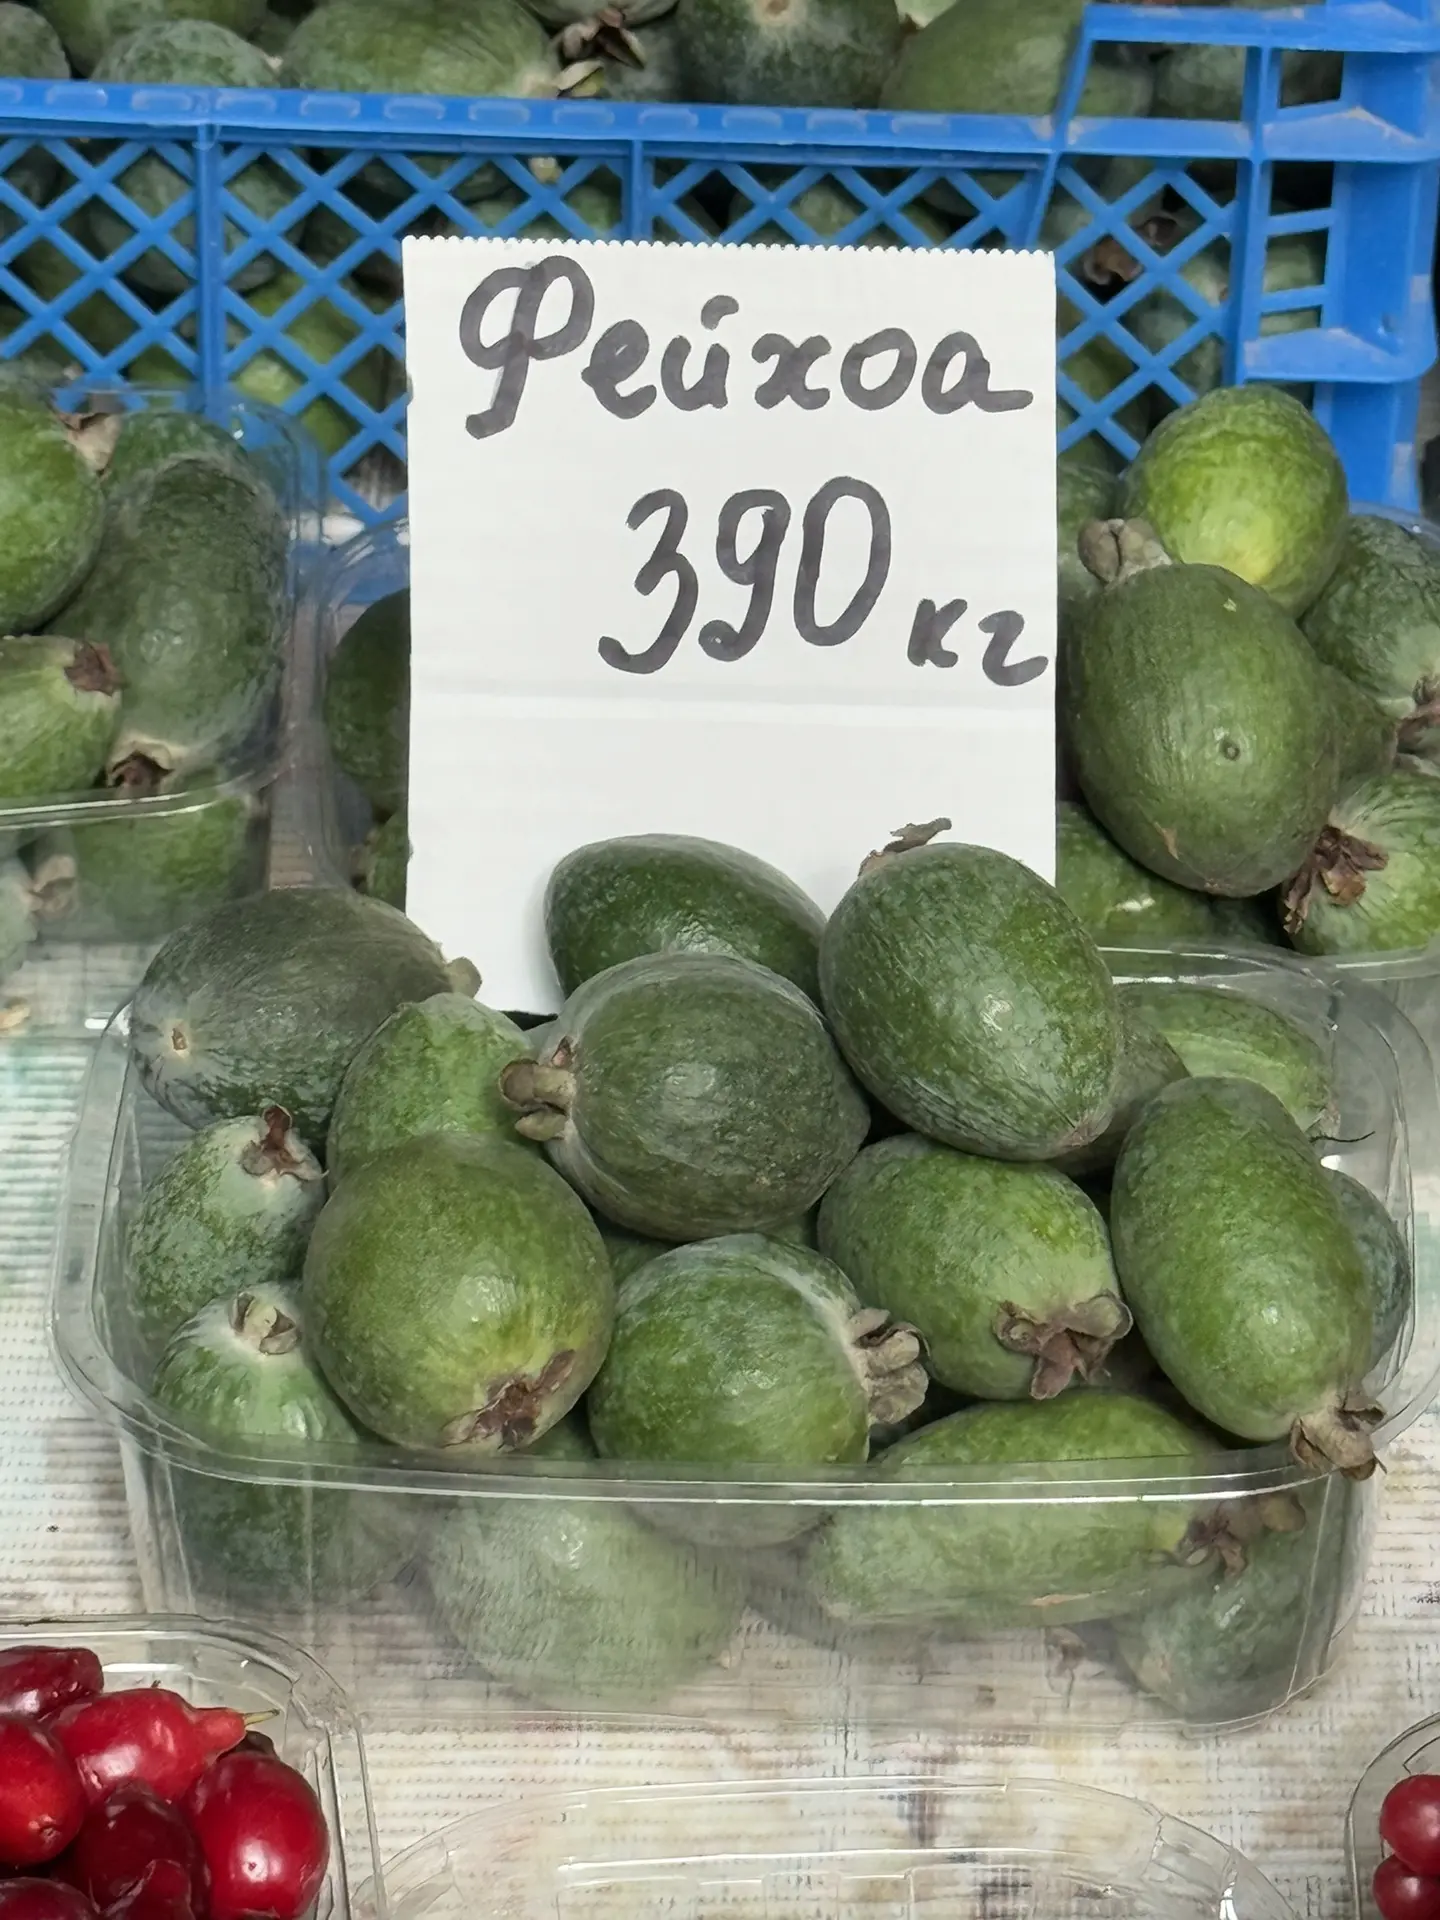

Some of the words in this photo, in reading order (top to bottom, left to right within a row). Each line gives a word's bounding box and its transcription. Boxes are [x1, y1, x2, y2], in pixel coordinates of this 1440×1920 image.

[459, 255, 1034, 440] Фейхоа
[598, 475, 892, 675] 390
[907, 598, 1049, 687] кг
